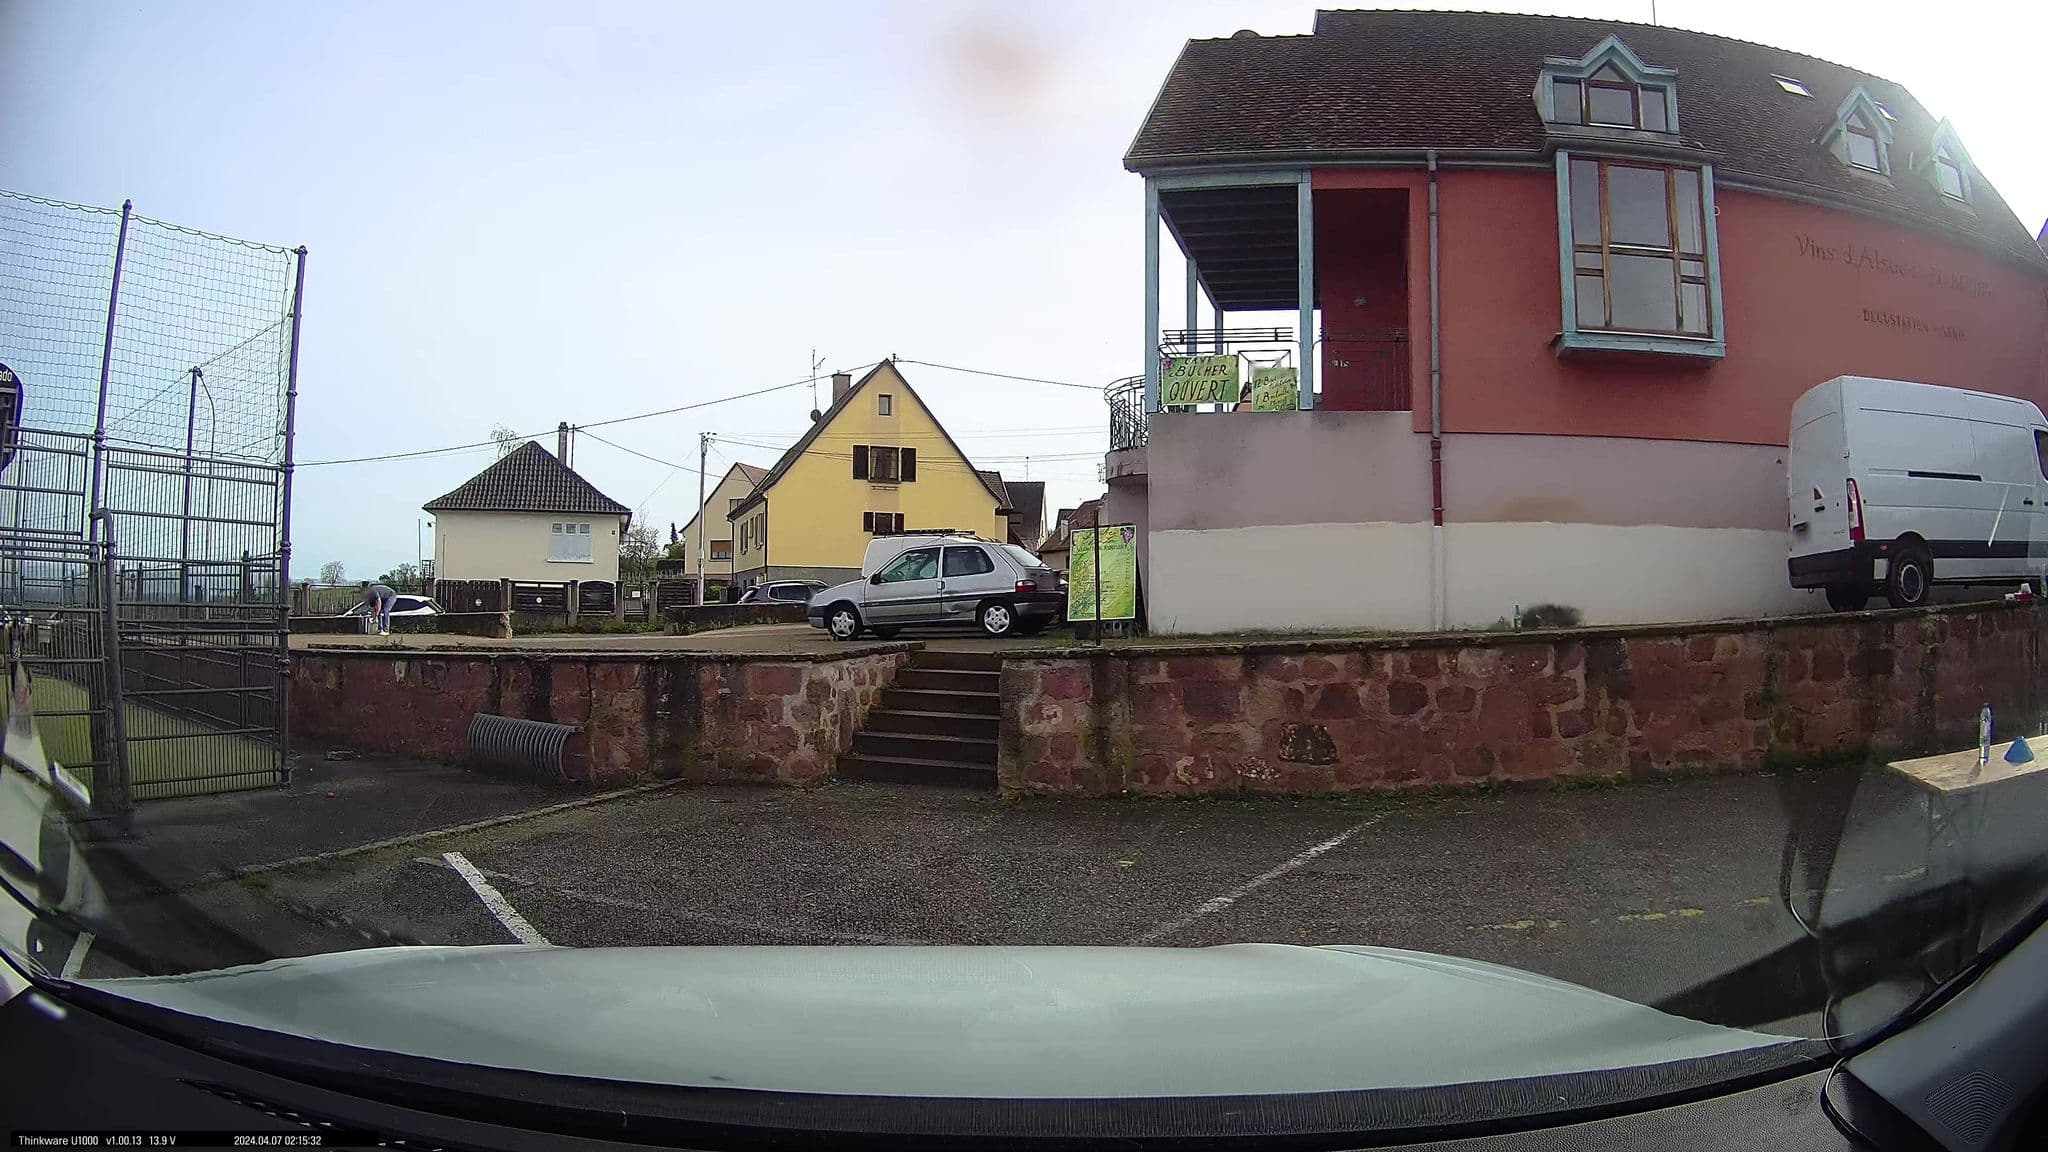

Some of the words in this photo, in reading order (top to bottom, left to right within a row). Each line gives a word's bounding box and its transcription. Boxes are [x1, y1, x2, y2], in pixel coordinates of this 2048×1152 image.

[1794, 233, 1834, 260] Vins
[1171, 365, 1228, 377] BUCHER
[1170, 380, 1229, 401] OUVERT
